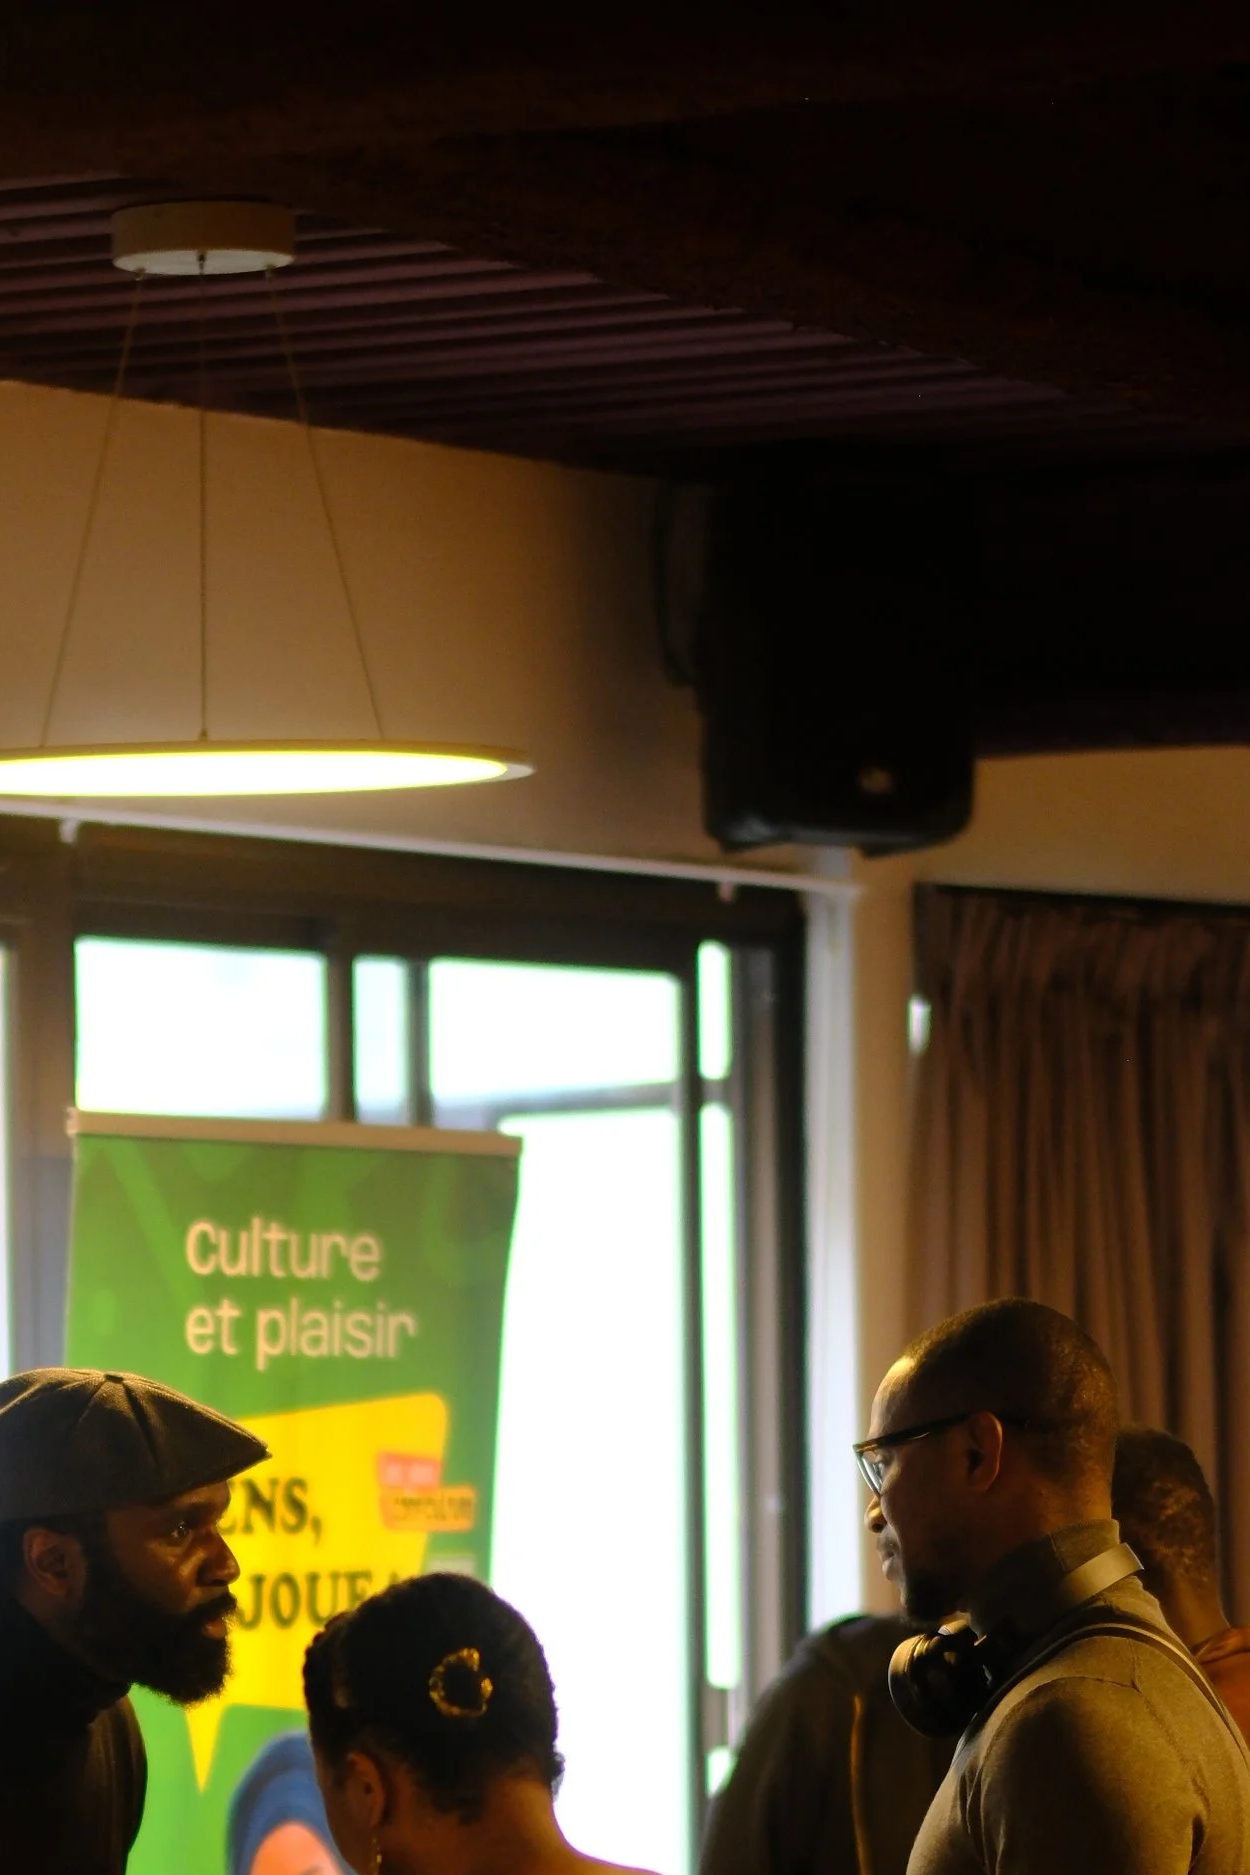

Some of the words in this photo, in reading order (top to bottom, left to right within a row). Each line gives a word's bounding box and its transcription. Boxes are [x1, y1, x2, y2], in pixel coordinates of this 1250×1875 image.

[185, 1216, 383, 1283] culture
[184, 1297, 242, 1356] et
[255, 1297, 417, 1372] plaisir
